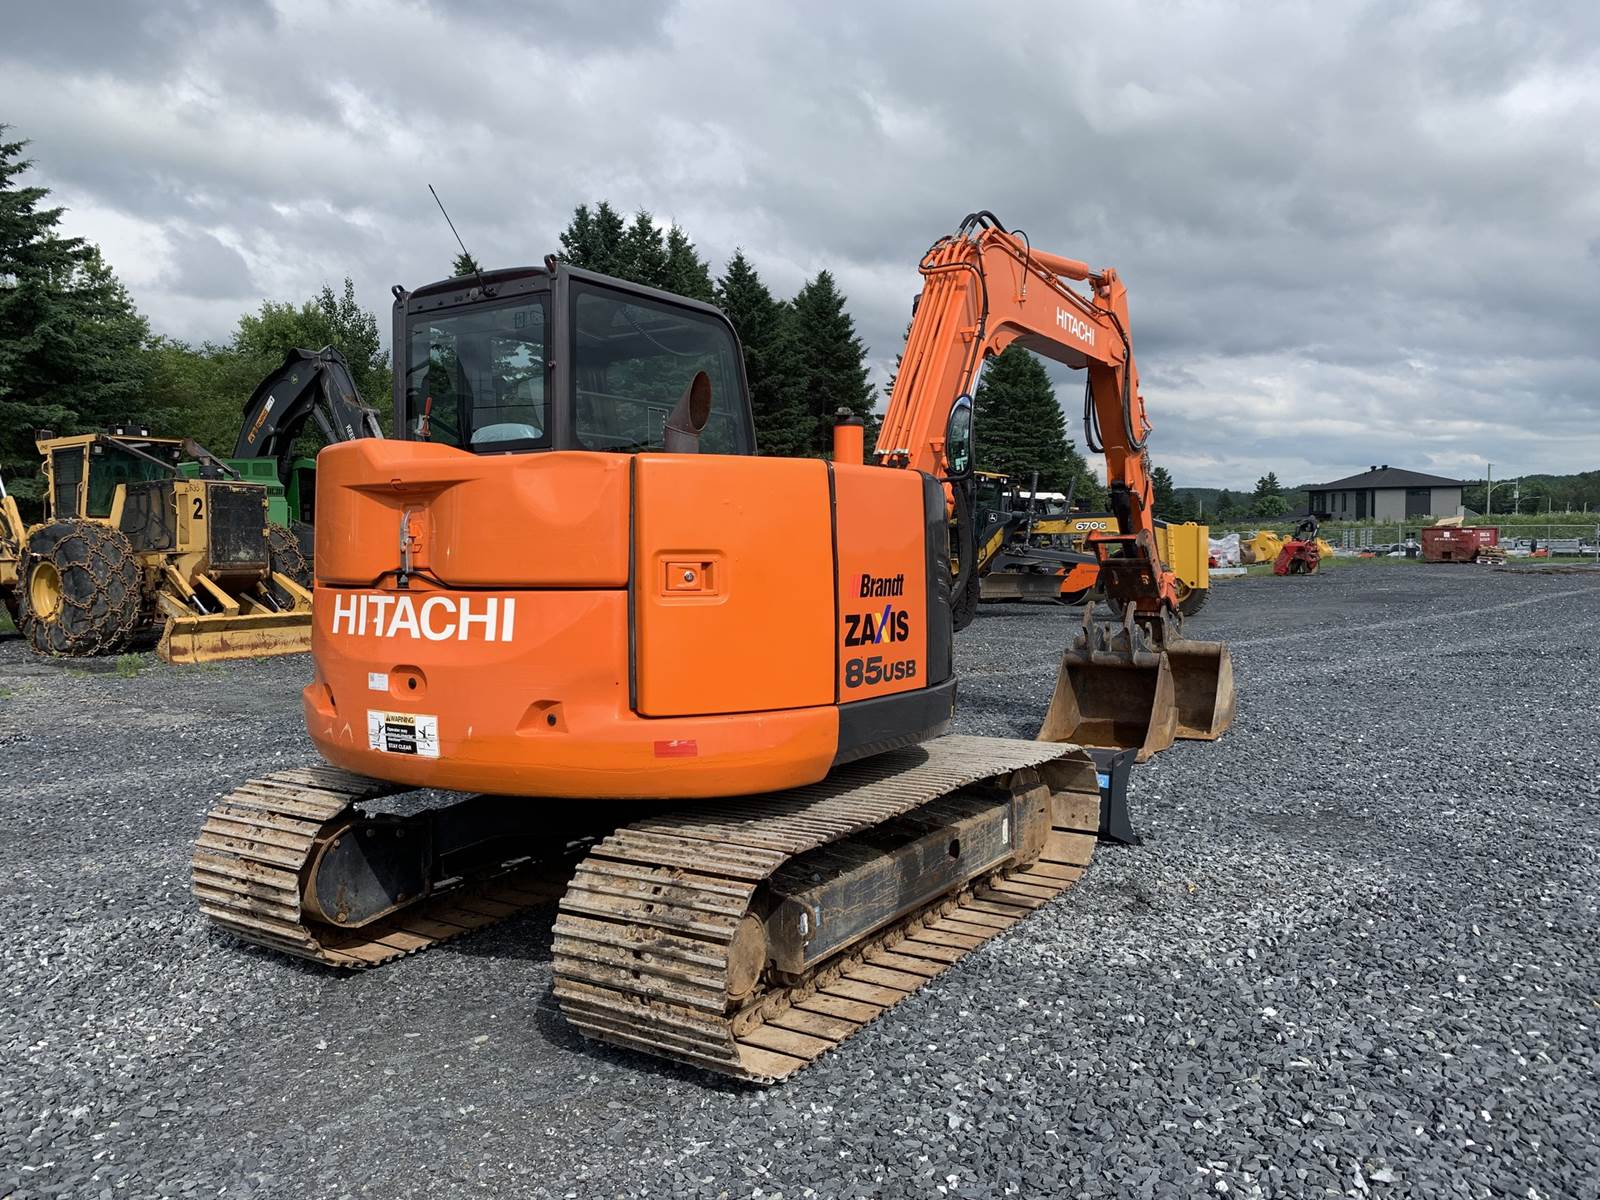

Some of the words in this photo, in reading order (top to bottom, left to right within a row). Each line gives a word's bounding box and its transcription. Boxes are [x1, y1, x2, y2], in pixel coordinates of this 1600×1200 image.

[1056, 306, 1095, 347] HITACHI
[192, 497, 204, 520] 2
[1075, 521, 1107, 531] 670G
[860, 574, 904, 598] Brandt
[332, 593, 516, 642] HITACHI
[844, 604, 909, 648] ZAXIS
[390, 715, 414, 724] WARNING
